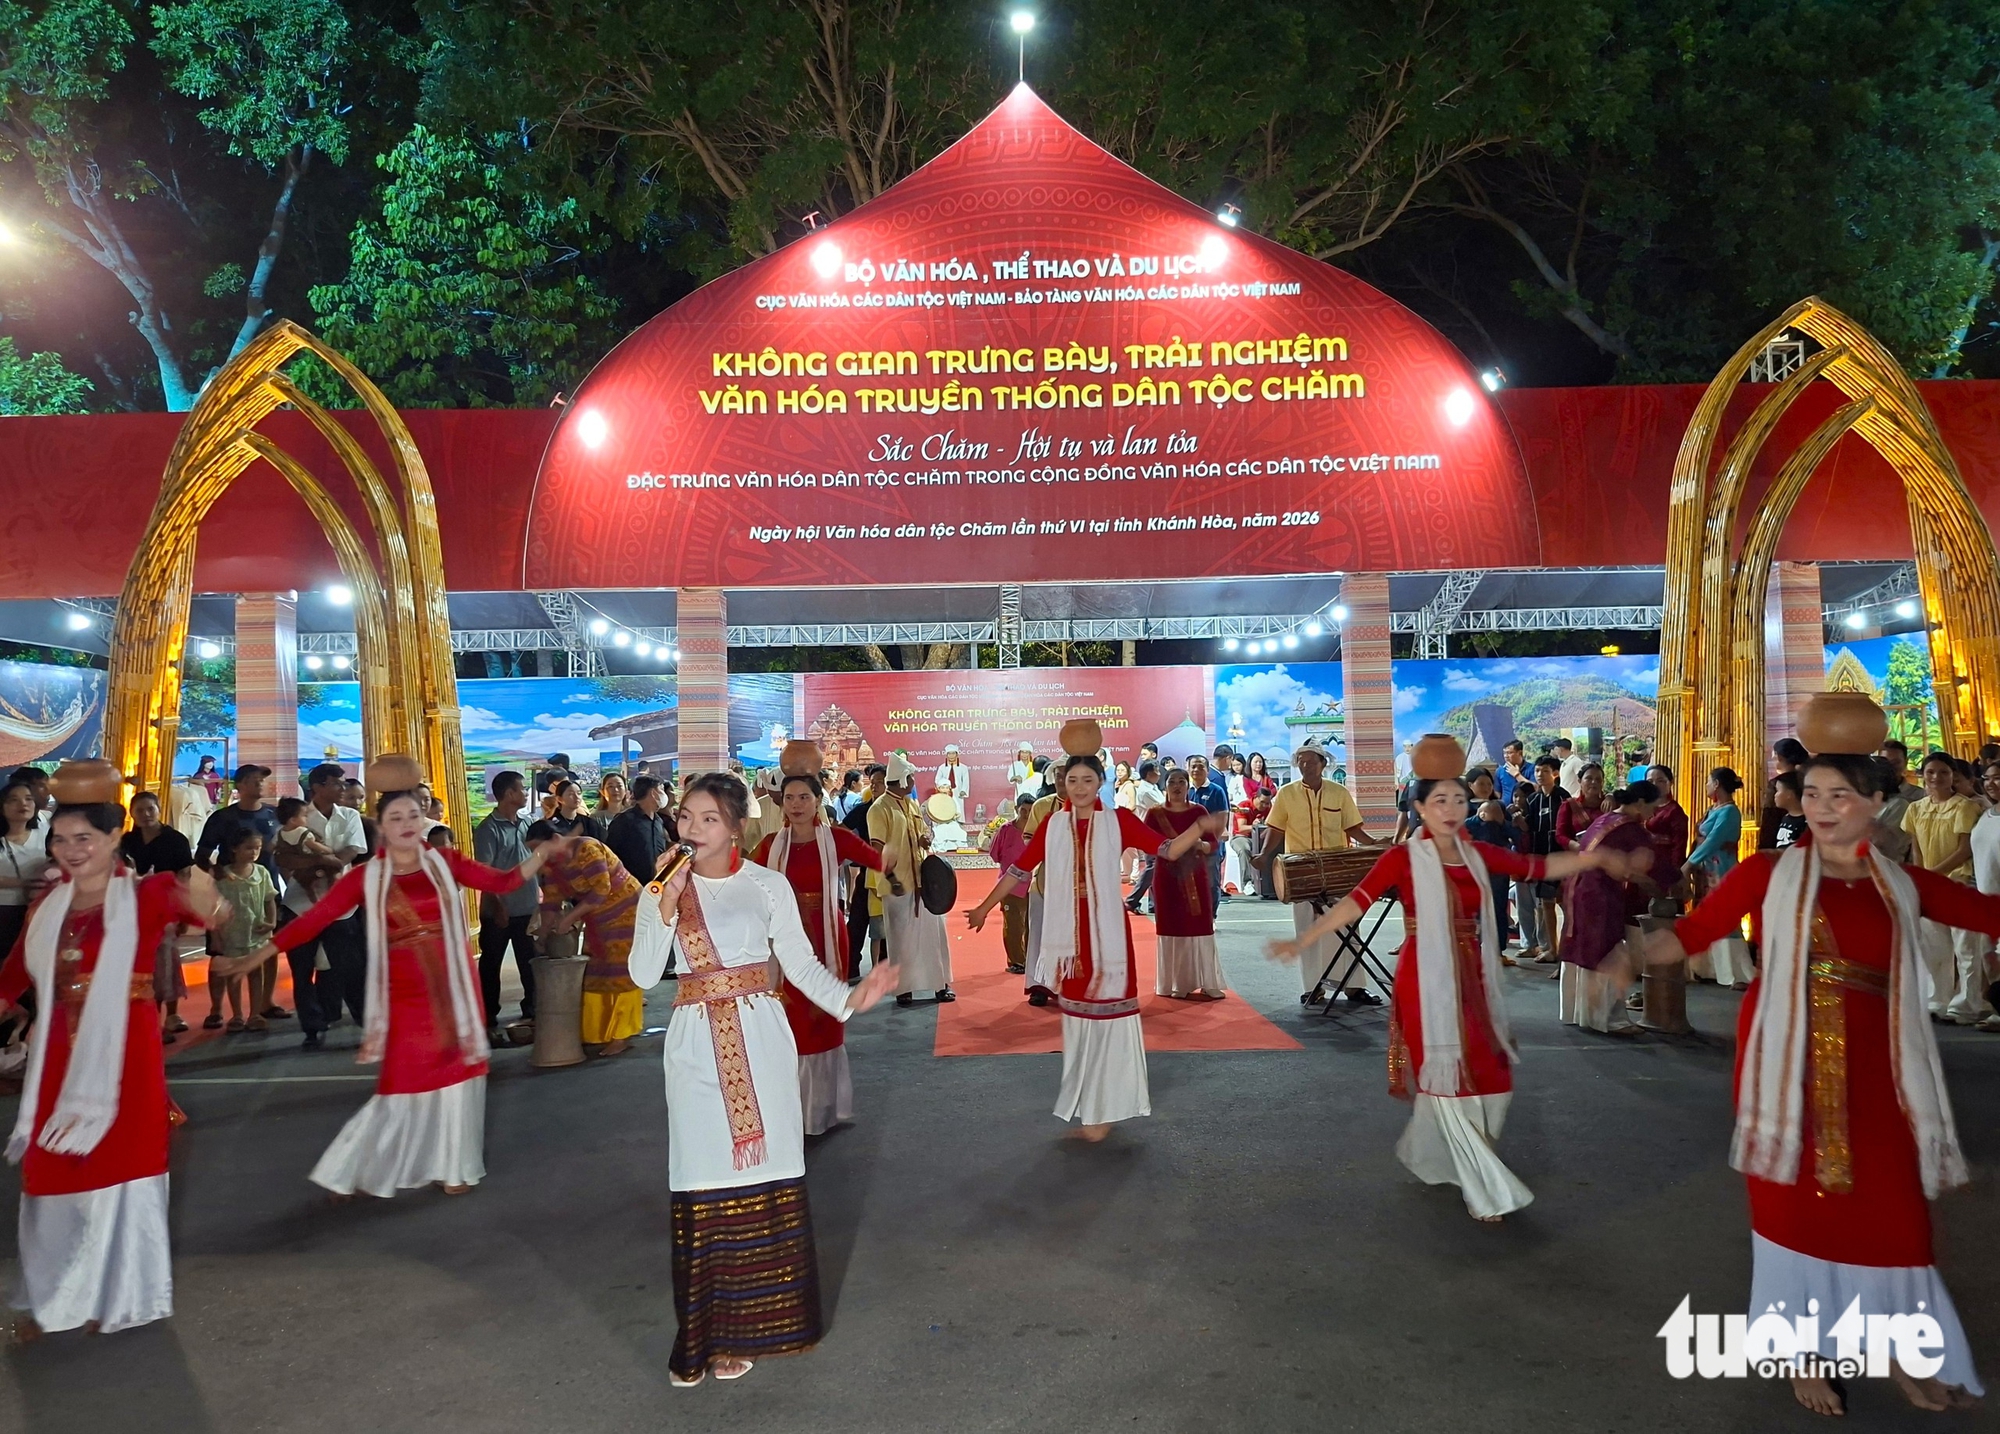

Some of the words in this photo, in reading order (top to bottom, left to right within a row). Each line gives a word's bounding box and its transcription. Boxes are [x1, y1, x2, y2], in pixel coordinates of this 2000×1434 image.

[844, 258, 876, 287] BỘ
[881, 259, 925, 282] VĂN
[930, 257, 978, 282] HÓA
[993, 251, 1029, 280] THỂ
[1033, 259, 1091, 279] THAO
[1093, 253, 1125, 278] VÀ
[1130, 257, 1159, 277] DU
[755, 295, 787, 312] CỤC
[788, 292, 817, 308] VĂN
[820, 291, 851, 308] HÓA
[853, 291, 884, 307] CÁC
[886, 291, 916, 306] DÂN
[917, 290, 945, 310] TỘC
[946, 290, 975, 310] VIỆT
[975, 293, 1006, 306] NAM
[1015, 287, 1044, 304] BẢO
[1045, 287, 1082, 304] TÀNG
[1083, 287, 1112, 303] VĂN
[1115, 286, 1144, 302] HÓA
[1147, 285, 1179, 300] CÁC
[1181, 284, 1210, 299] DÂN
[1211, 283, 1240, 301] TỘC
[1242, 282, 1269, 301] VIỆT
[1270, 282, 1300, 296] NAM
[712, 346, 828, 378] KHÔNG
[835, 350, 918, 377] GIAN
[925, 345, 1035, 375] TRƯNG
[1043, 341, 1119, 375] BÀY,
[1124, 336, 1203, 370] TRẢI
[1211, 332, 1348, 369] NGHIỆM
[698, 384, 768, 415] VĂN
[777, 384, 847, 415] HÓA
[854, 379, 984, 415] TRUYỀN
[990, 376, 1103, 410] THỐNG
[1111, 376, 1181, 407] DÂN
[1187, 373, 1254, 409] TỘC
[1261, 369, 1365, 402] CHĂM
[868, 433, 914, 462] Sắc
[921, 429, 989, 462] Chăm
[1008, 426, 1053, 467] Hội
[1058, 438, 1083, 461] tụ
[1090, 433, 1116, 457] và
[1121, 424, 1158, 456] lan
[1166, 429, 1198, 454] tỏa
[626, 471, 667, 492] ĐẶC
[670, 472, 732, 489] TRƯNG
[735, 471, 773, 488] VĂN
[777, 470, 817, 488] HÓA
[821, 470, 861, 488] DÂN
[865, 469, 900, 490] TỘC
[904, 468, 961, 486] CHĂM
[965, 468, 1026, 485] TRONG
[1030, 465, 1080, 486] CỘNG
[1084, 463, 1137, 482] ĐỒNG
[1140, 463, 1178, 480] VĂN
[1182, 460, 1222, 478] HÓA
[1225, 458, 1263, 477] CÁC
[1266, 457, 1306, 475] DÂN
[1309, 455, 1346, 476] TỘC
[1349, 453, 1391, 474] VIỆT
[1393, 454, 1441, 471] NAM
[749, 524, 793, 543] Ngày
[795, 523, 821, 543] hội
[825, 524, 856, 539] Văn
[859, 523, 891, 539] hóa
[894, 522, 926, 538] dân
[929, 522, 956, 541] tộc
[959, 520, 1007, 537] Chăm
[1011, 517, 1036, 535] lần
[1040, 518, 1067, 534] thứ
[1070, 519, 1086, 534] VI
[1089, 519, 1111, 537] tại
[1114, 516, 1143, 532] tỉnh
[1147, 514, 1197, 531] Khánh
[1200, 513, 1238, 531] Hòa,
[1241, 512, 1278, 528] năm
[1281, 511, 1321, 526] 2026
[883, 721, 909, 733] VĂN
[912, 721, 938, 732] HÓA
[941, 719, 988, 732] TRUYỀN
[991, 719, 1033, 731] THỐNG
[1035, 718, 1061, 730] DÂN
[1095, 717, 1129, 729] HĂM
[888, 708, 931, 720] KHÔNG
[934, 709, 964, 719] GIAN
[967, 708, 1007, 719] TRƯNG
[1010, 706, 1038, 718] BÀY,
[1040, 705, 1070, 717] TRẢI
[1072, 704, 1123, 718] NGHIỆM
